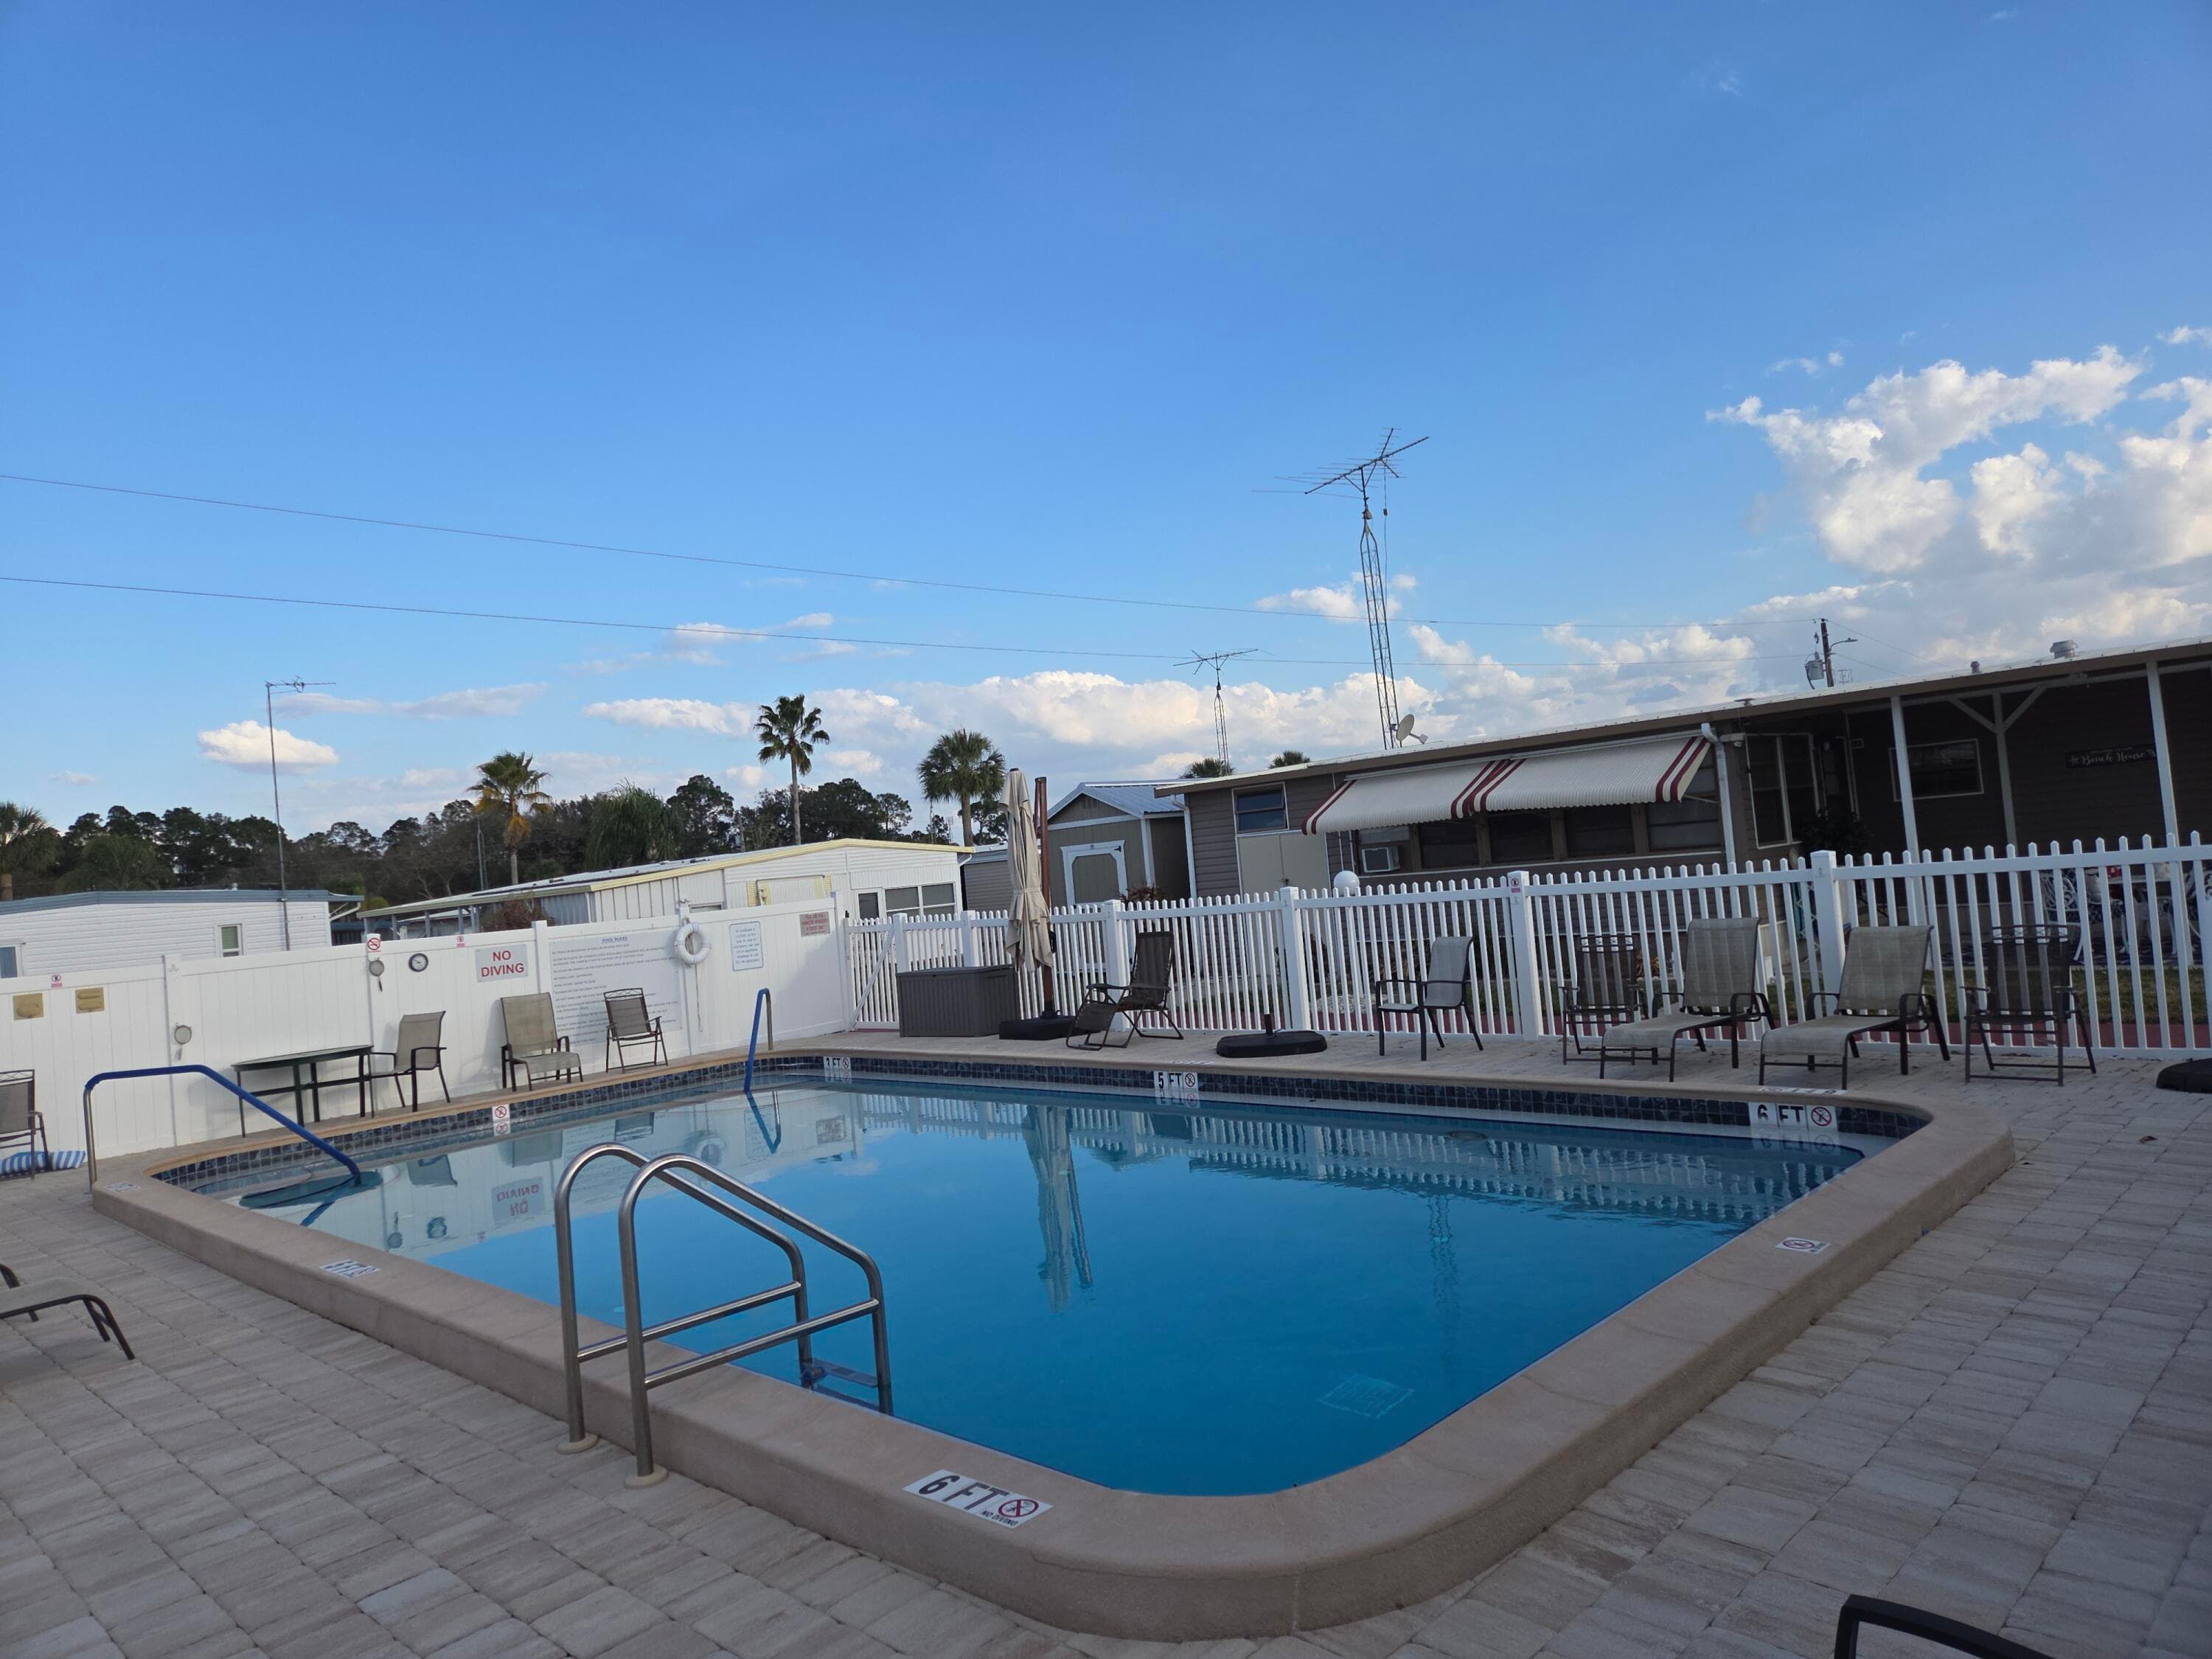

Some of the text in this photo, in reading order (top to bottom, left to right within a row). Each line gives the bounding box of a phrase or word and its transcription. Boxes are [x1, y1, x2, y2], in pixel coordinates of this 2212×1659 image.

[493, 950, 511, 961] NO
[481, 963, 524, 977] DIVING
[833, 1057, 841, 1067] FT
[1158, 1072, 1181, 1088] 5 FT
[1757, 1105, 1804, 1123] 6 FT
[918, 1475, 1010, 1510] 6 FT
[991, 1514, 1019, 1526] DIVING
